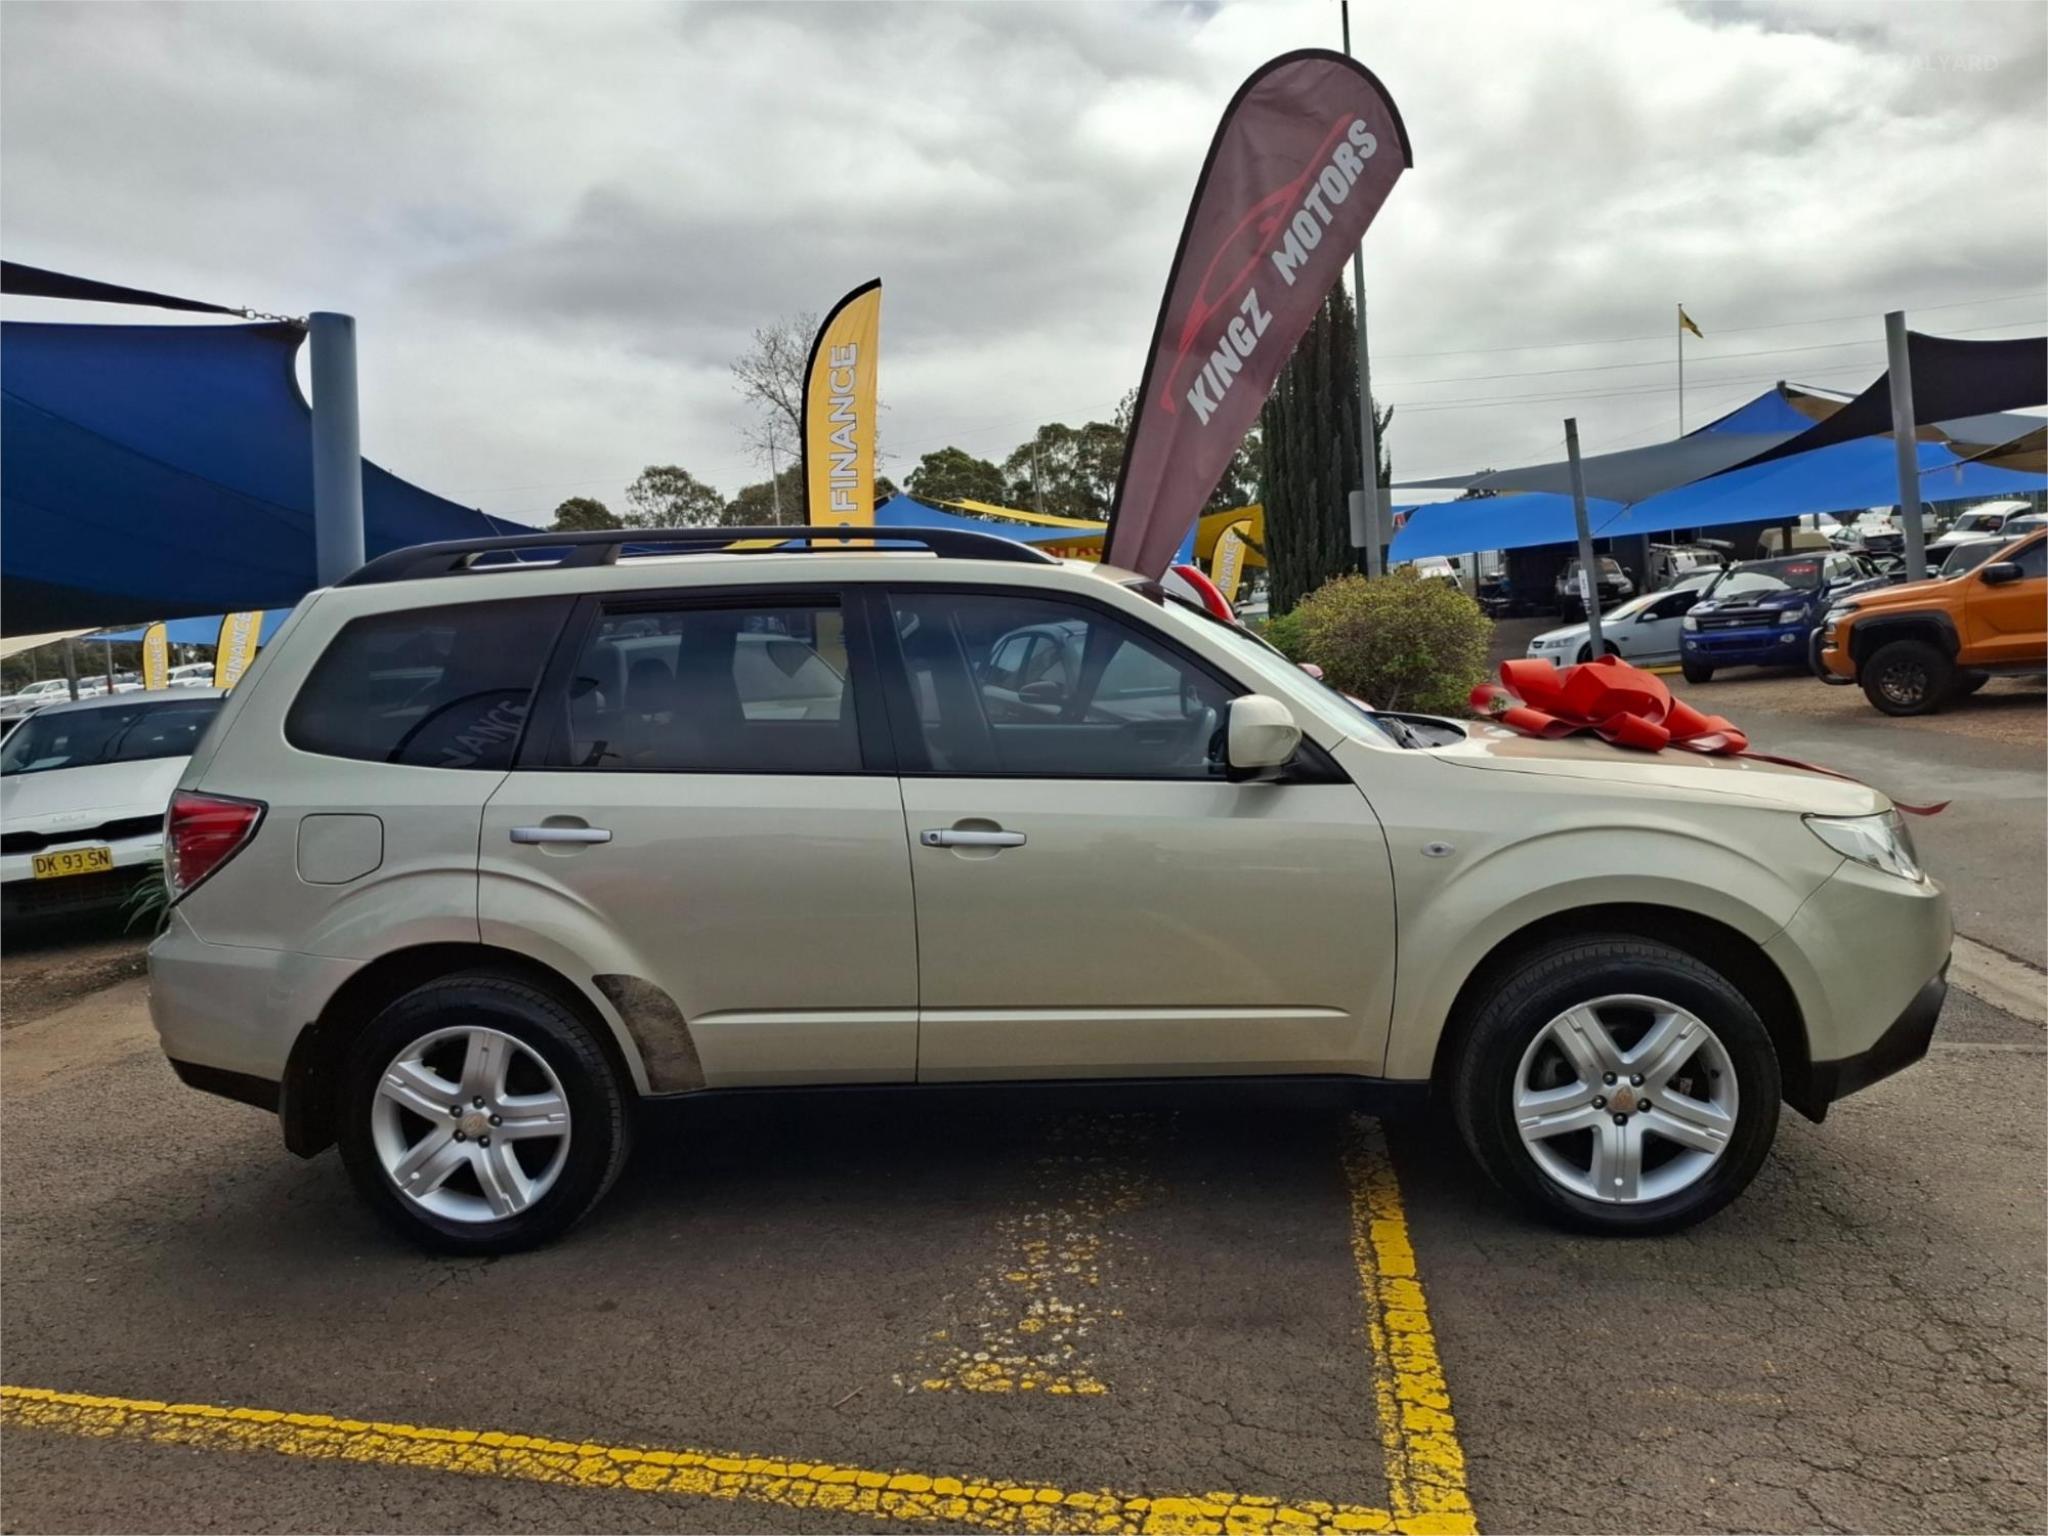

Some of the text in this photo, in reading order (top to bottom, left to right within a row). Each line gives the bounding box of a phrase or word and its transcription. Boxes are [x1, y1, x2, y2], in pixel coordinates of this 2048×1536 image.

[1186, 118, 1378, 426] KINGZ MOTORS
[828, 342, 859, 513] FINANCE
[35, 857, 58, 874] DK
[62, 854, 84, 870] 93
[87, 850, 109, 867] SN
